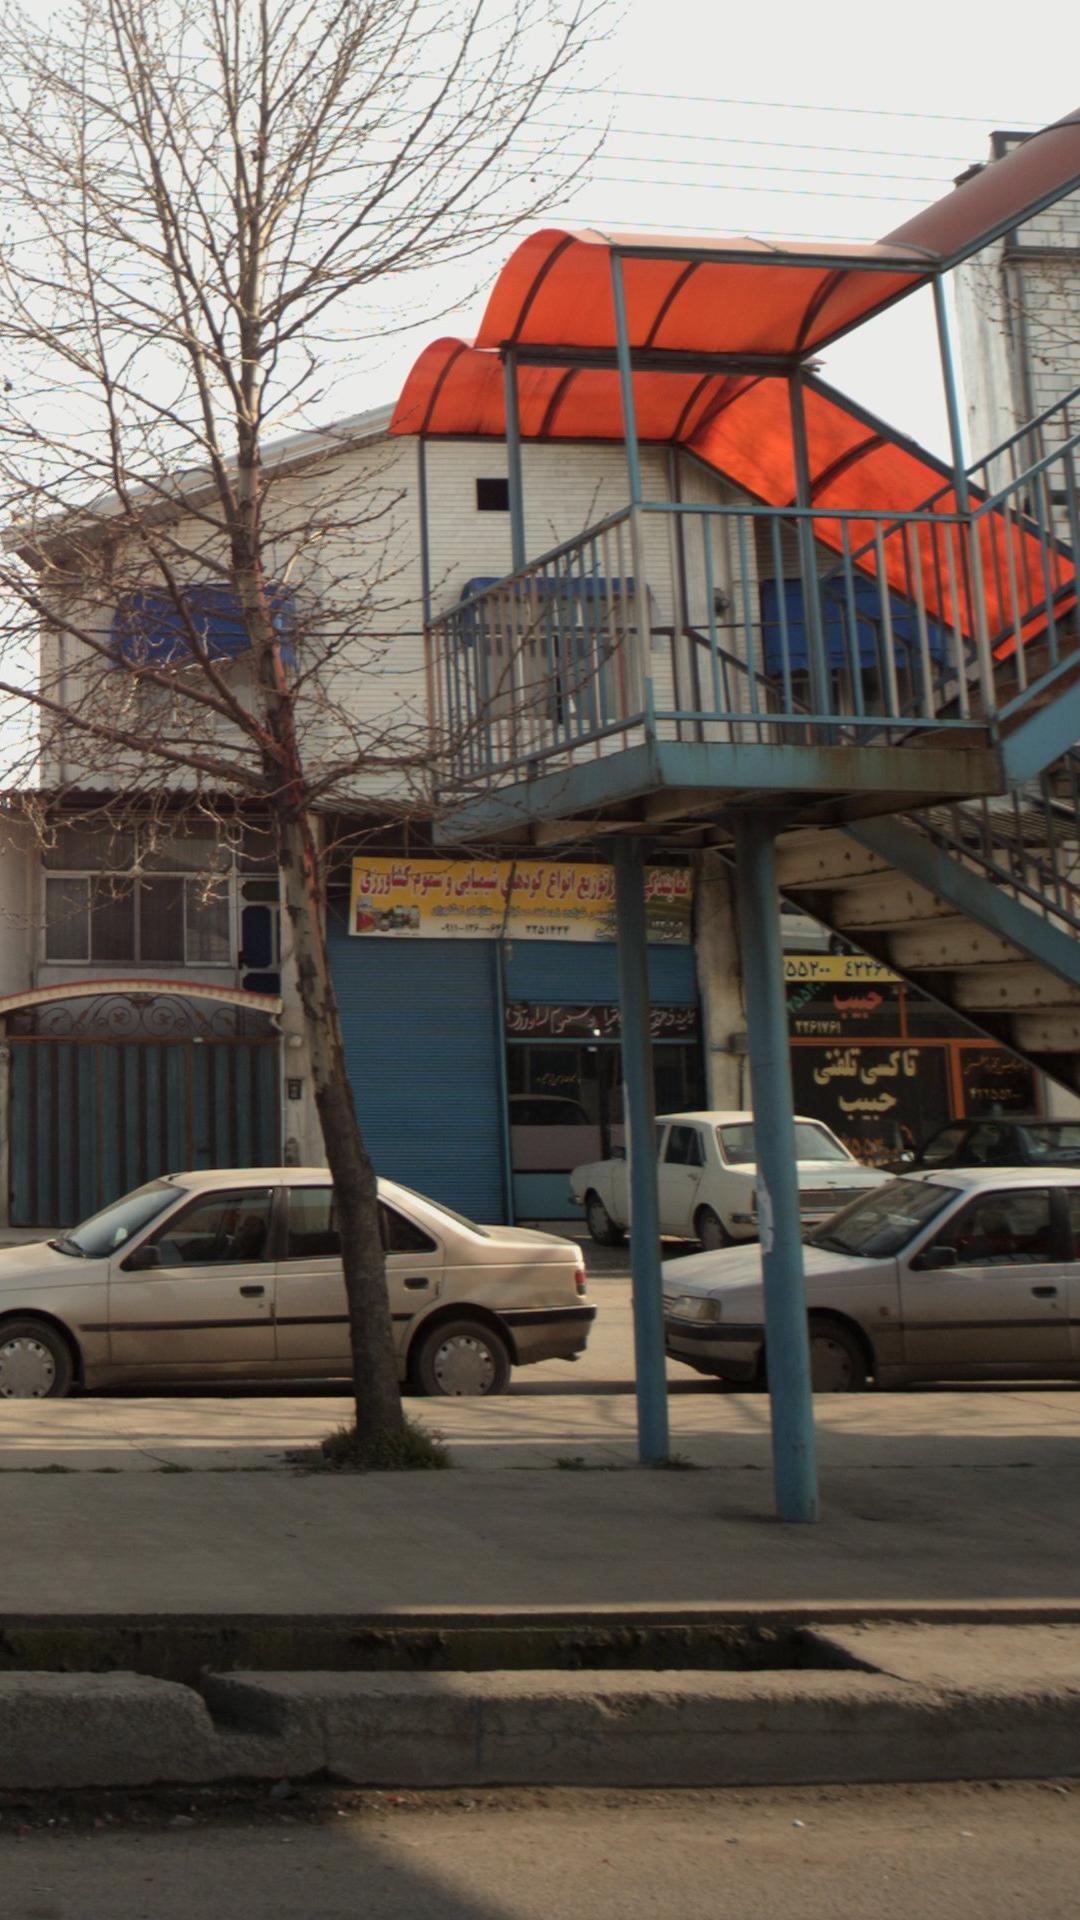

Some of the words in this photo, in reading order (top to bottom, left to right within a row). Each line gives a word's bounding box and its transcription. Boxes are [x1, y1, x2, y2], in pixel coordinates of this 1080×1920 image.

[360, 864, 412, 895] کشاورزی
[413, 873, 443, 897] سموم
[445, 876, 453, 897] و
[454, 866, 498, 897] شیمیایی
[545, 868, 575, 899] انواع
[785, 960, 831, 977] ۵۵۲۰۰
[833, 991, 883, 1019] حبیب
[814, 1047, 861, 1085] تلفنی
[861, 1048, 920, 1085] تاکسی
[838, 1092, 897, 1121] حبیب
